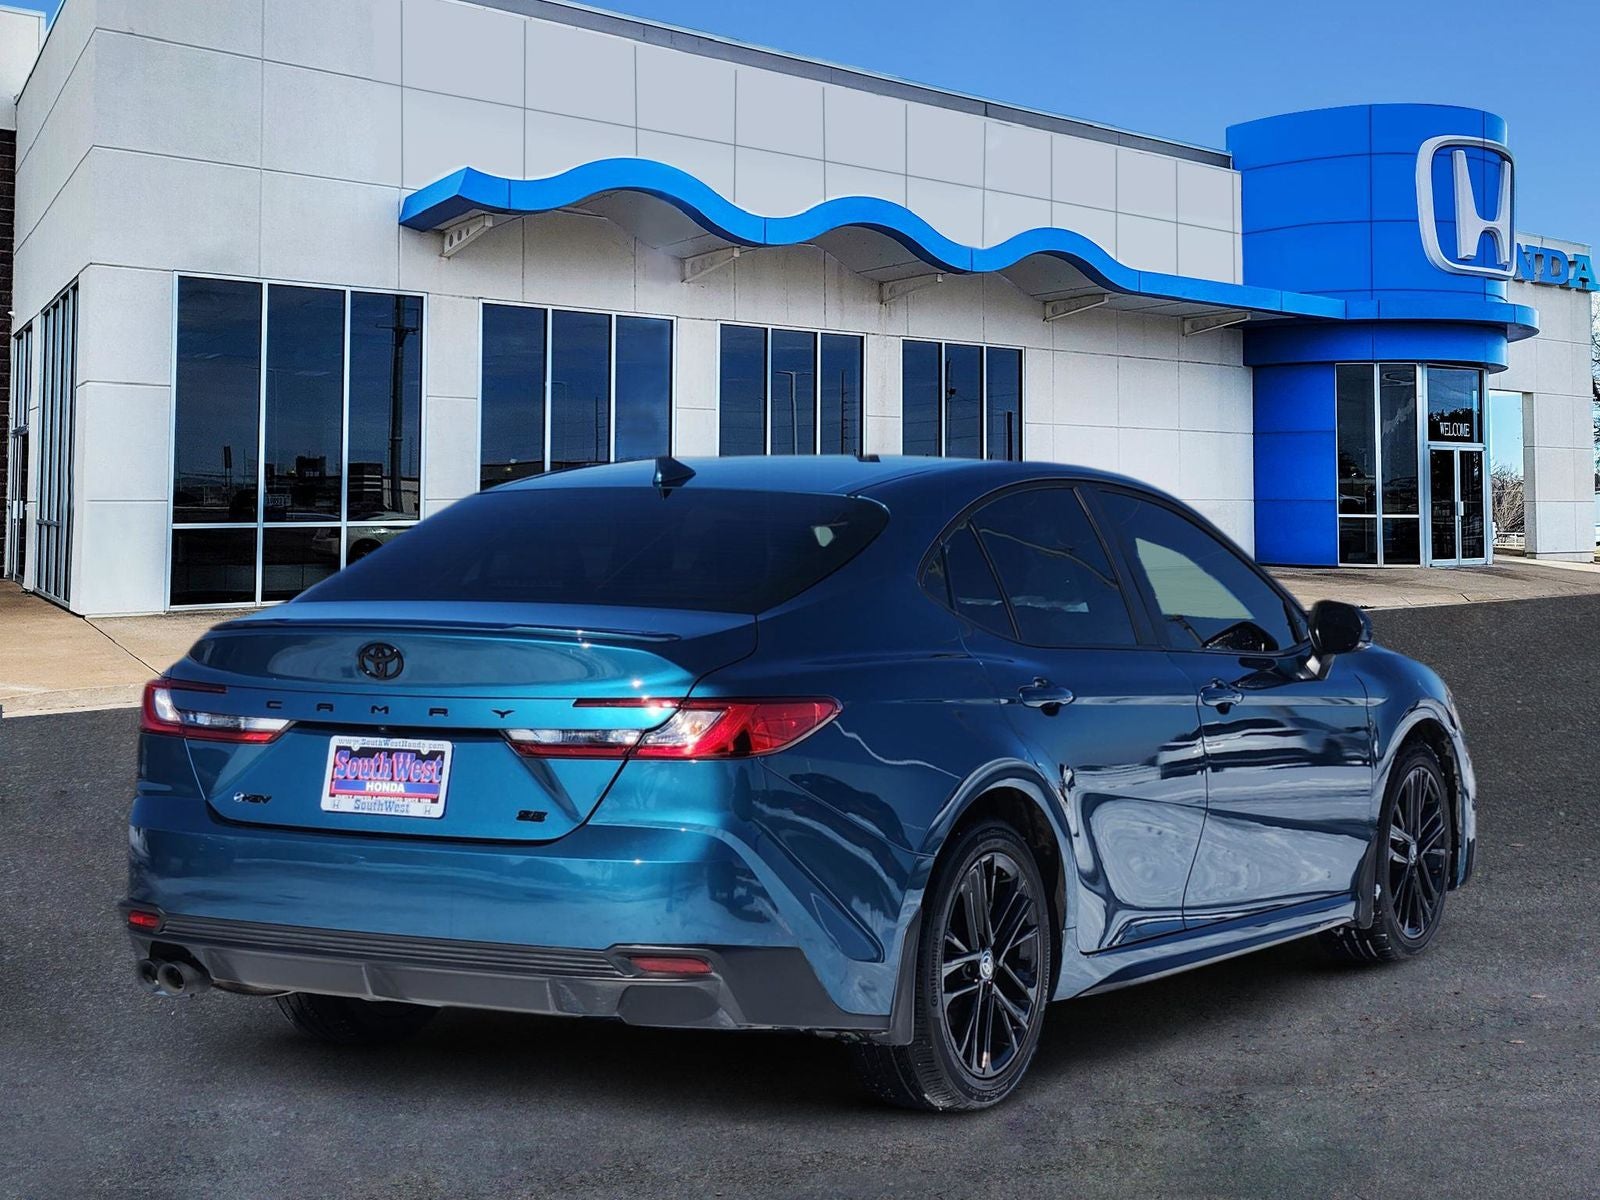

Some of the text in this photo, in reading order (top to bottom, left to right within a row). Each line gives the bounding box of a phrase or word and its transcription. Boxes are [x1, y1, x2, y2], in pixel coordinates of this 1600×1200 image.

[1440, 422, 1470, 437] WELCOME
[266, 700, 515, 719] CAMRY
[366, 782, 405, 792] HONDA
